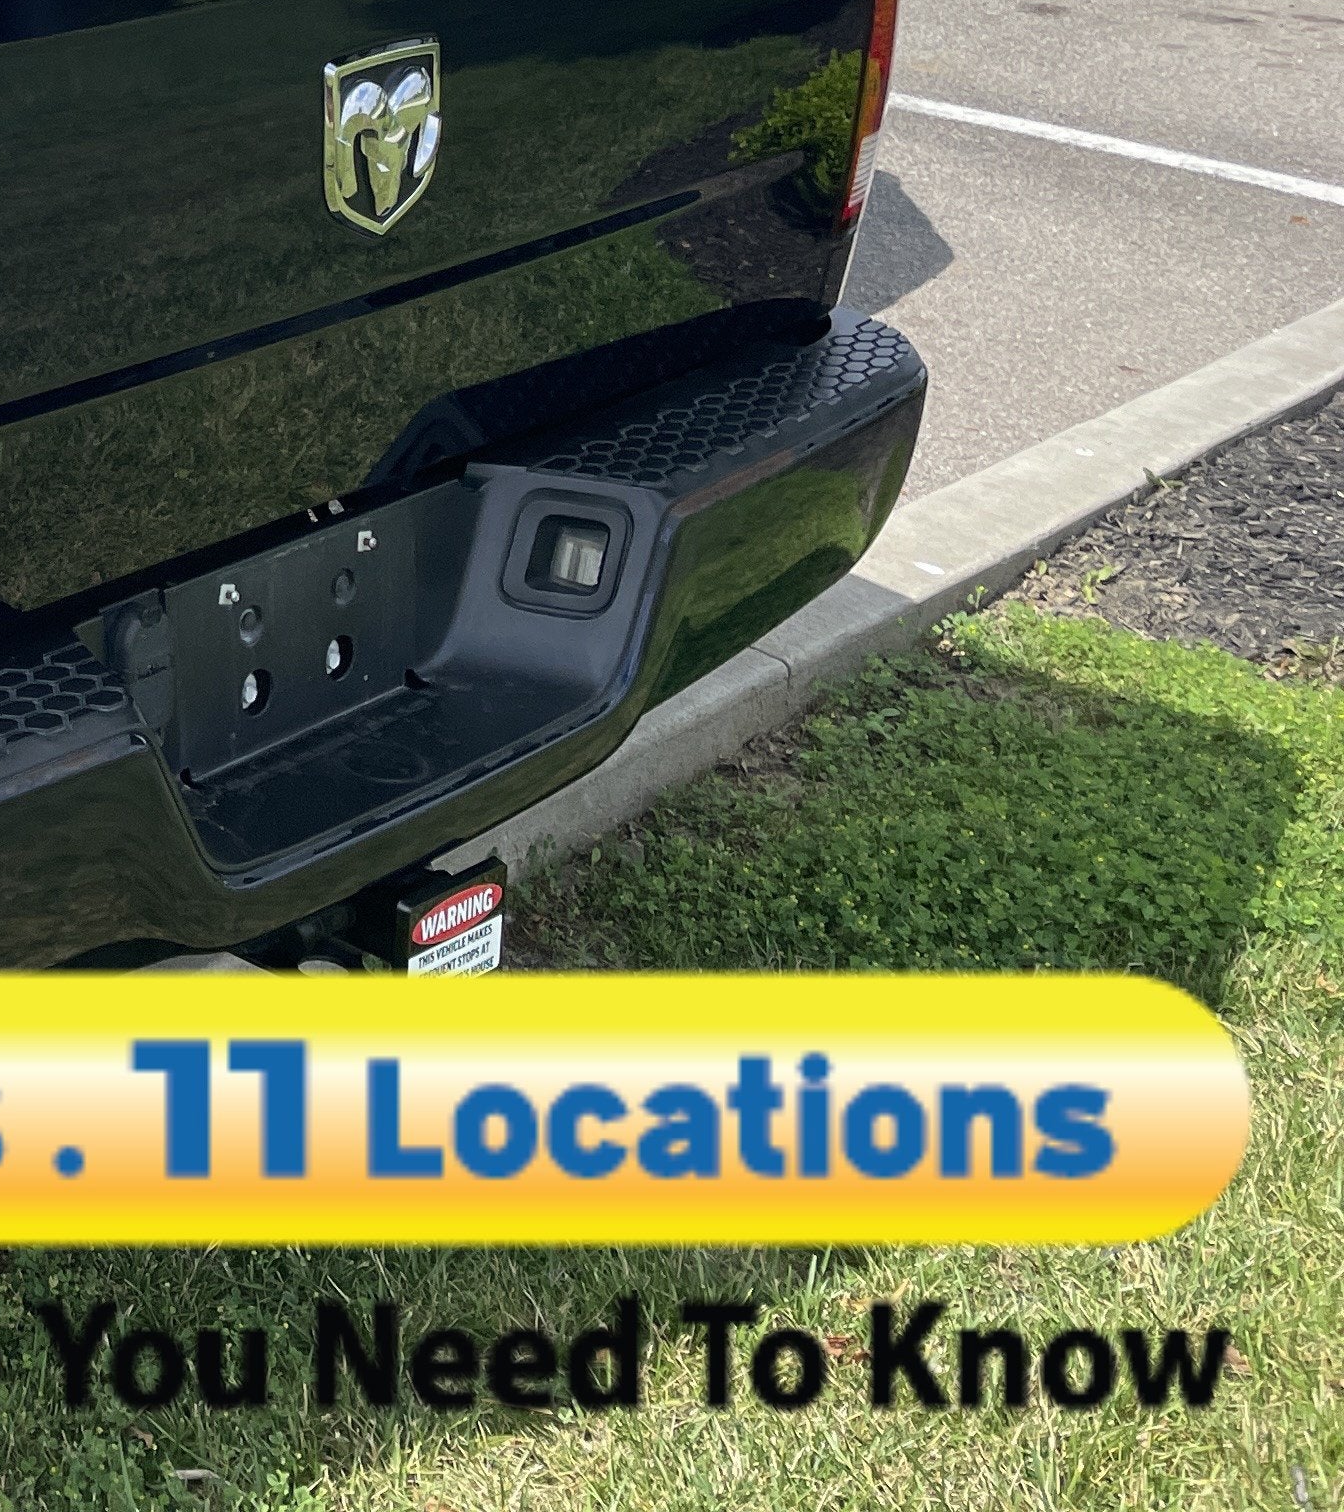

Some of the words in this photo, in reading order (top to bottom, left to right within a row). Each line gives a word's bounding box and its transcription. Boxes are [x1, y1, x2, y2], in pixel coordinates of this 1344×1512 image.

[420, 888, 494, 942] WARNING
[418, 952, 435, 969] THIS
[436, 936, 466, 961] VEHICLE
[468, 923, 493, 944] MAKES
[457, 947, 480, 968] STOPS
[481, 940, 491, 955] AT
